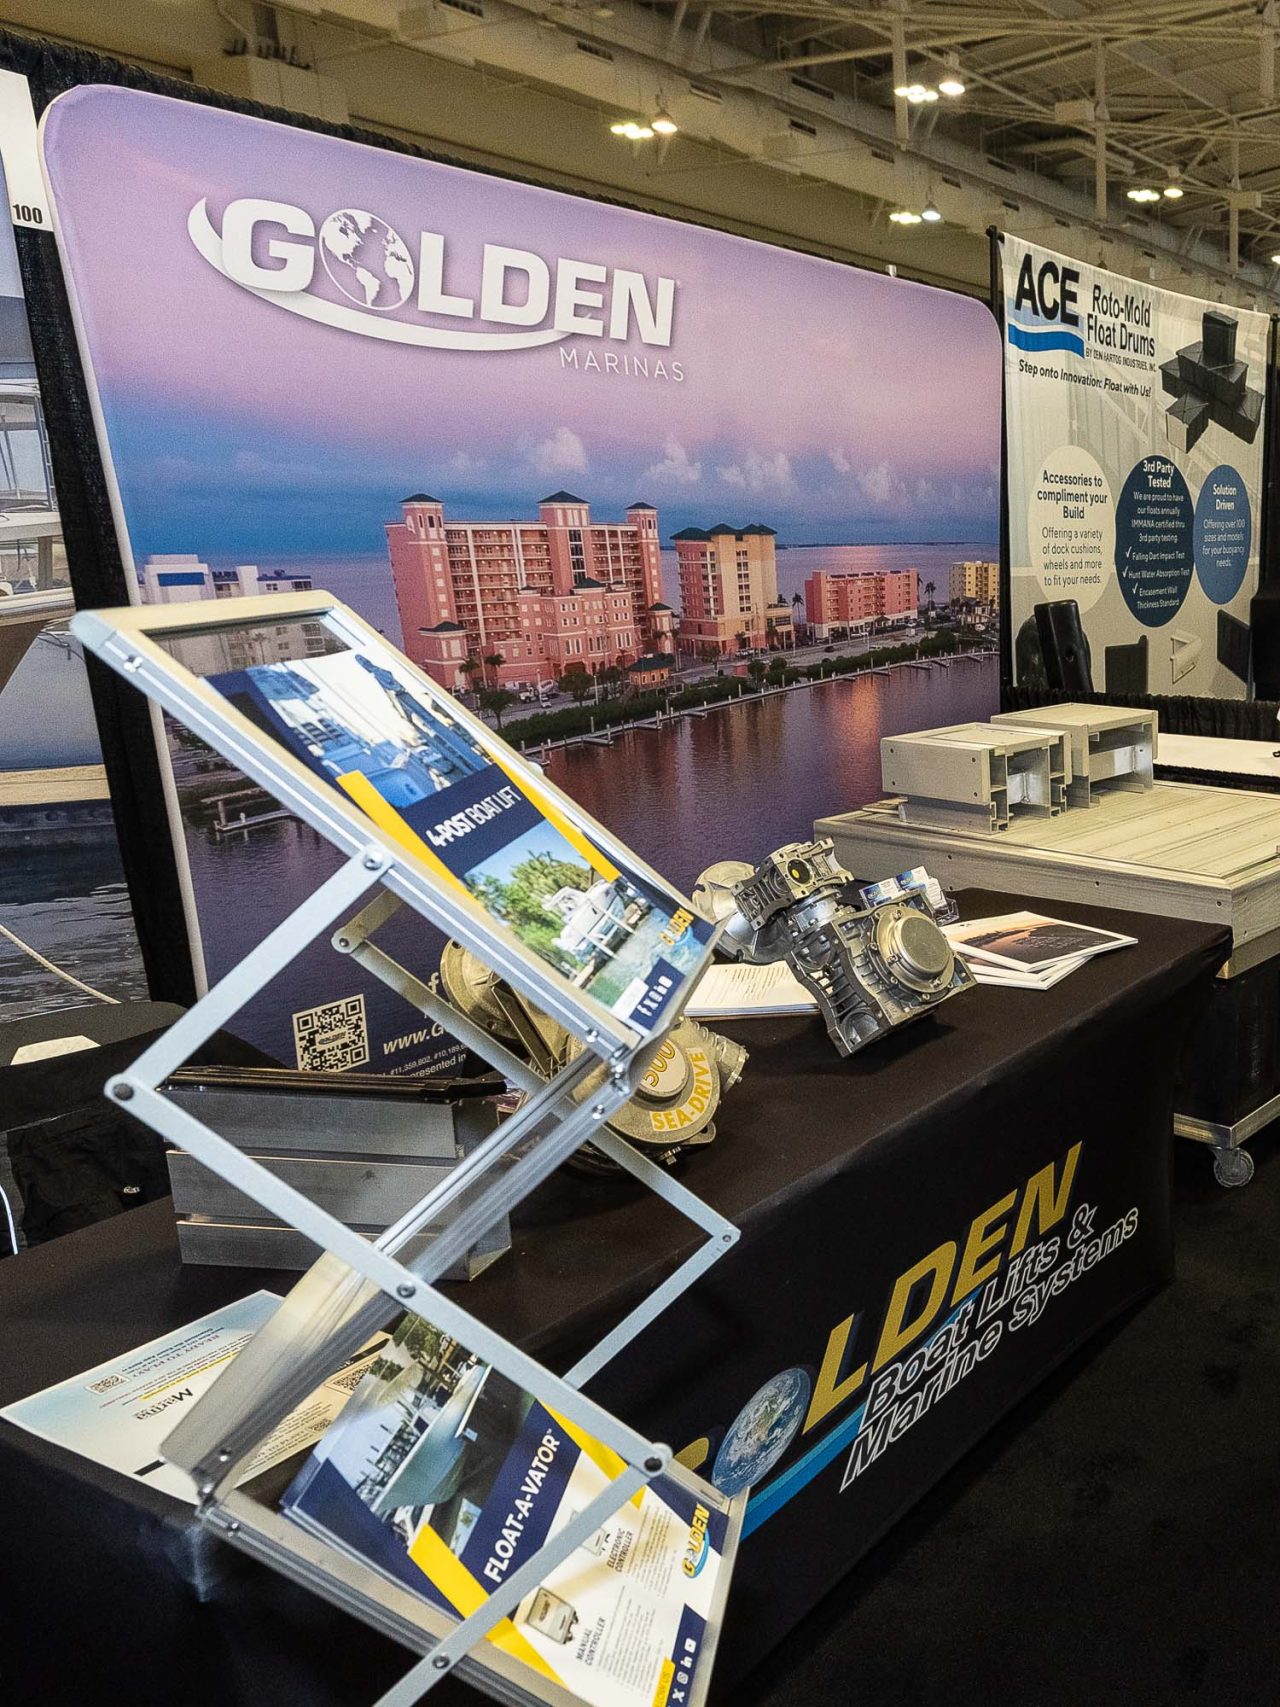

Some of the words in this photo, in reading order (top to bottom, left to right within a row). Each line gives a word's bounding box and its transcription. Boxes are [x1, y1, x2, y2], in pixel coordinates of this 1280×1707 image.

[12, 204, 43, 225] 100
[222, 197, 675, 347] GOLDEN
[1014, 252, 1080, 328] ACE
[1092, 284, 1151, 329] Roto-Mold
[1087, 313, 1117, 348] Float
[1120, 322, 1156, 357] Drums
[559, 346, 685, 382] MARINAS
[1019, 359, 1039, 377] Step
[1040, 366, 1059, 379] onto
[1060, 368, 1102, 389] Innovation:
[1104, 377, 1122, 392] Float
[1123, 382, 1139, 395] with
[1140, 385, 1152, 398] Us!
[1042, 469, 1092, 487] Accessories
[1094, 476, 1103, 487] to
[1142, 460, 1155, 473] 3rd
[1156, 461, 1175, 476] Party
[1147, 475, 1171, 488] Tested
[1037, 489, 1088, 505] compliment
[1090, 493, 1108, 506] your
[1213, 483, 1237, 496] Solution
[1215, 499, 1235, 511] Driven
[1063, 505, 1085, 519] Build
[1042, 526, 1072, 541] Offering
[1074, 530, 1079, 539] a
[1080, 527, 1103, 541] variety
[1042, 543, 1051, 554] of
[1051, 543, 1069, 555] dock
[1070, 543, 1103, 555] cushions,
[1043, 559, 1068, 570] wheels
[1070, 559, 1083, 570] and
[1084, 560, 1102, 569] more
[1044, 576, 1052, 586] to
[1053, 575, 1061, 586] fit
[1063, 576, 1078, 588] your
[425, 811, 477, 847] 4-POST
[464, 796, 503, 825] BOAT
[496, 785, 522, 809] LIFT
[458, 1053, 467, 1063] in
[651, 1052, 712, 1130] SEA-DRIVE
[858, 1299, 975, 1434] Boat
[975, 1233, 1060, 1330] Lifts
[1067, 1203, 1098, 1249] &
[839, 1318, 1004, 1493] Marine
[1008, 1208, 1139, 1332] Systems
[484, 1431, 561, 1583] FLOAT-A-VATOR
[606, 1527, 626, 1569] ELECTRONIC
[615, 1531, 634, 1573] CONTROLLER
[682, 1504, 711, 1578] GOLDEN
[576, 1628, 593, 1662] MANUAL
[584, 1617, 607, 1667] CONTROLLER
